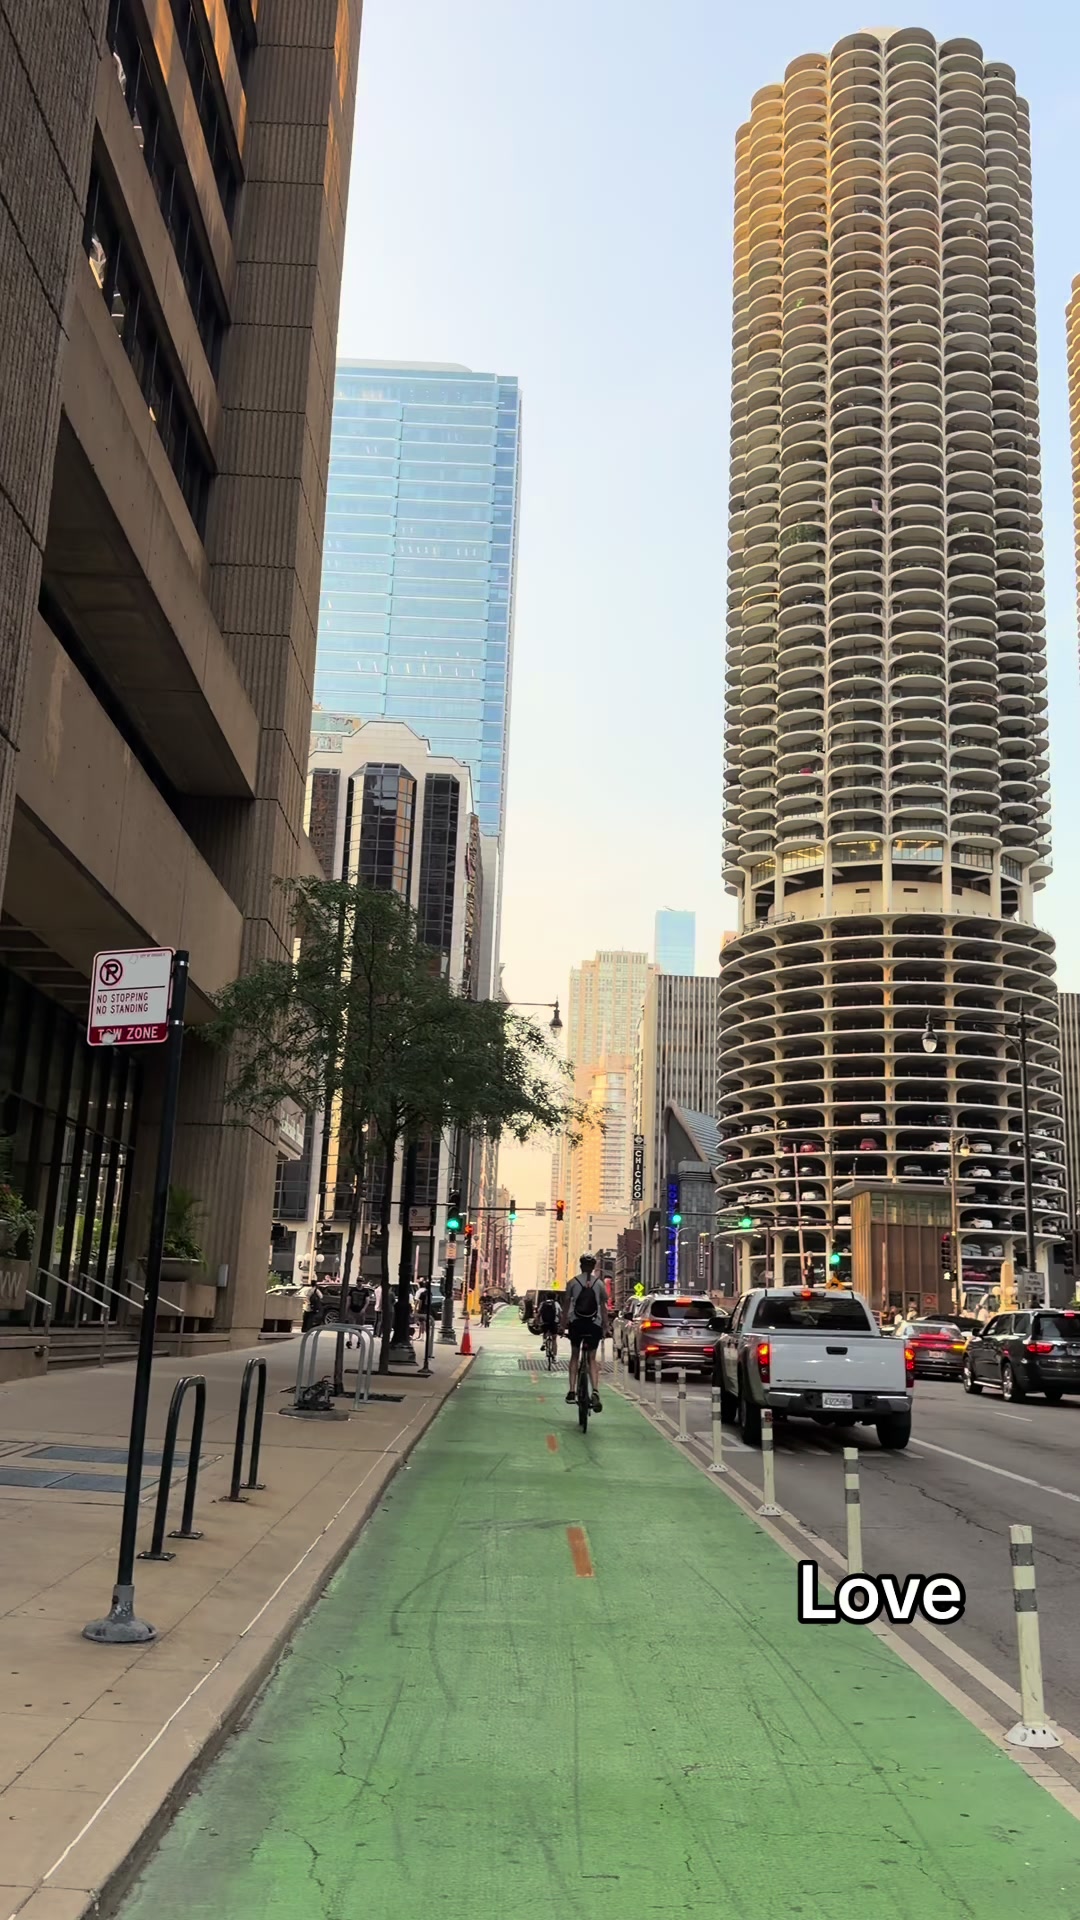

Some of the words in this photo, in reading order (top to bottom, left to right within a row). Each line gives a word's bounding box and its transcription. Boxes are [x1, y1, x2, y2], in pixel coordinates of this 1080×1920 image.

[97, 995, 108, 1004] NO
[110, 992, 149, 1003] STOPPING
[96, 1006, 107, 1015] NO
[110, 1003, 149, 1014] STANDING
[98, 1028, 122, 1041] TW
[126, 1026, 158, 1040] ZONE
[634, 1150, 643, 1199] CHICAGO
